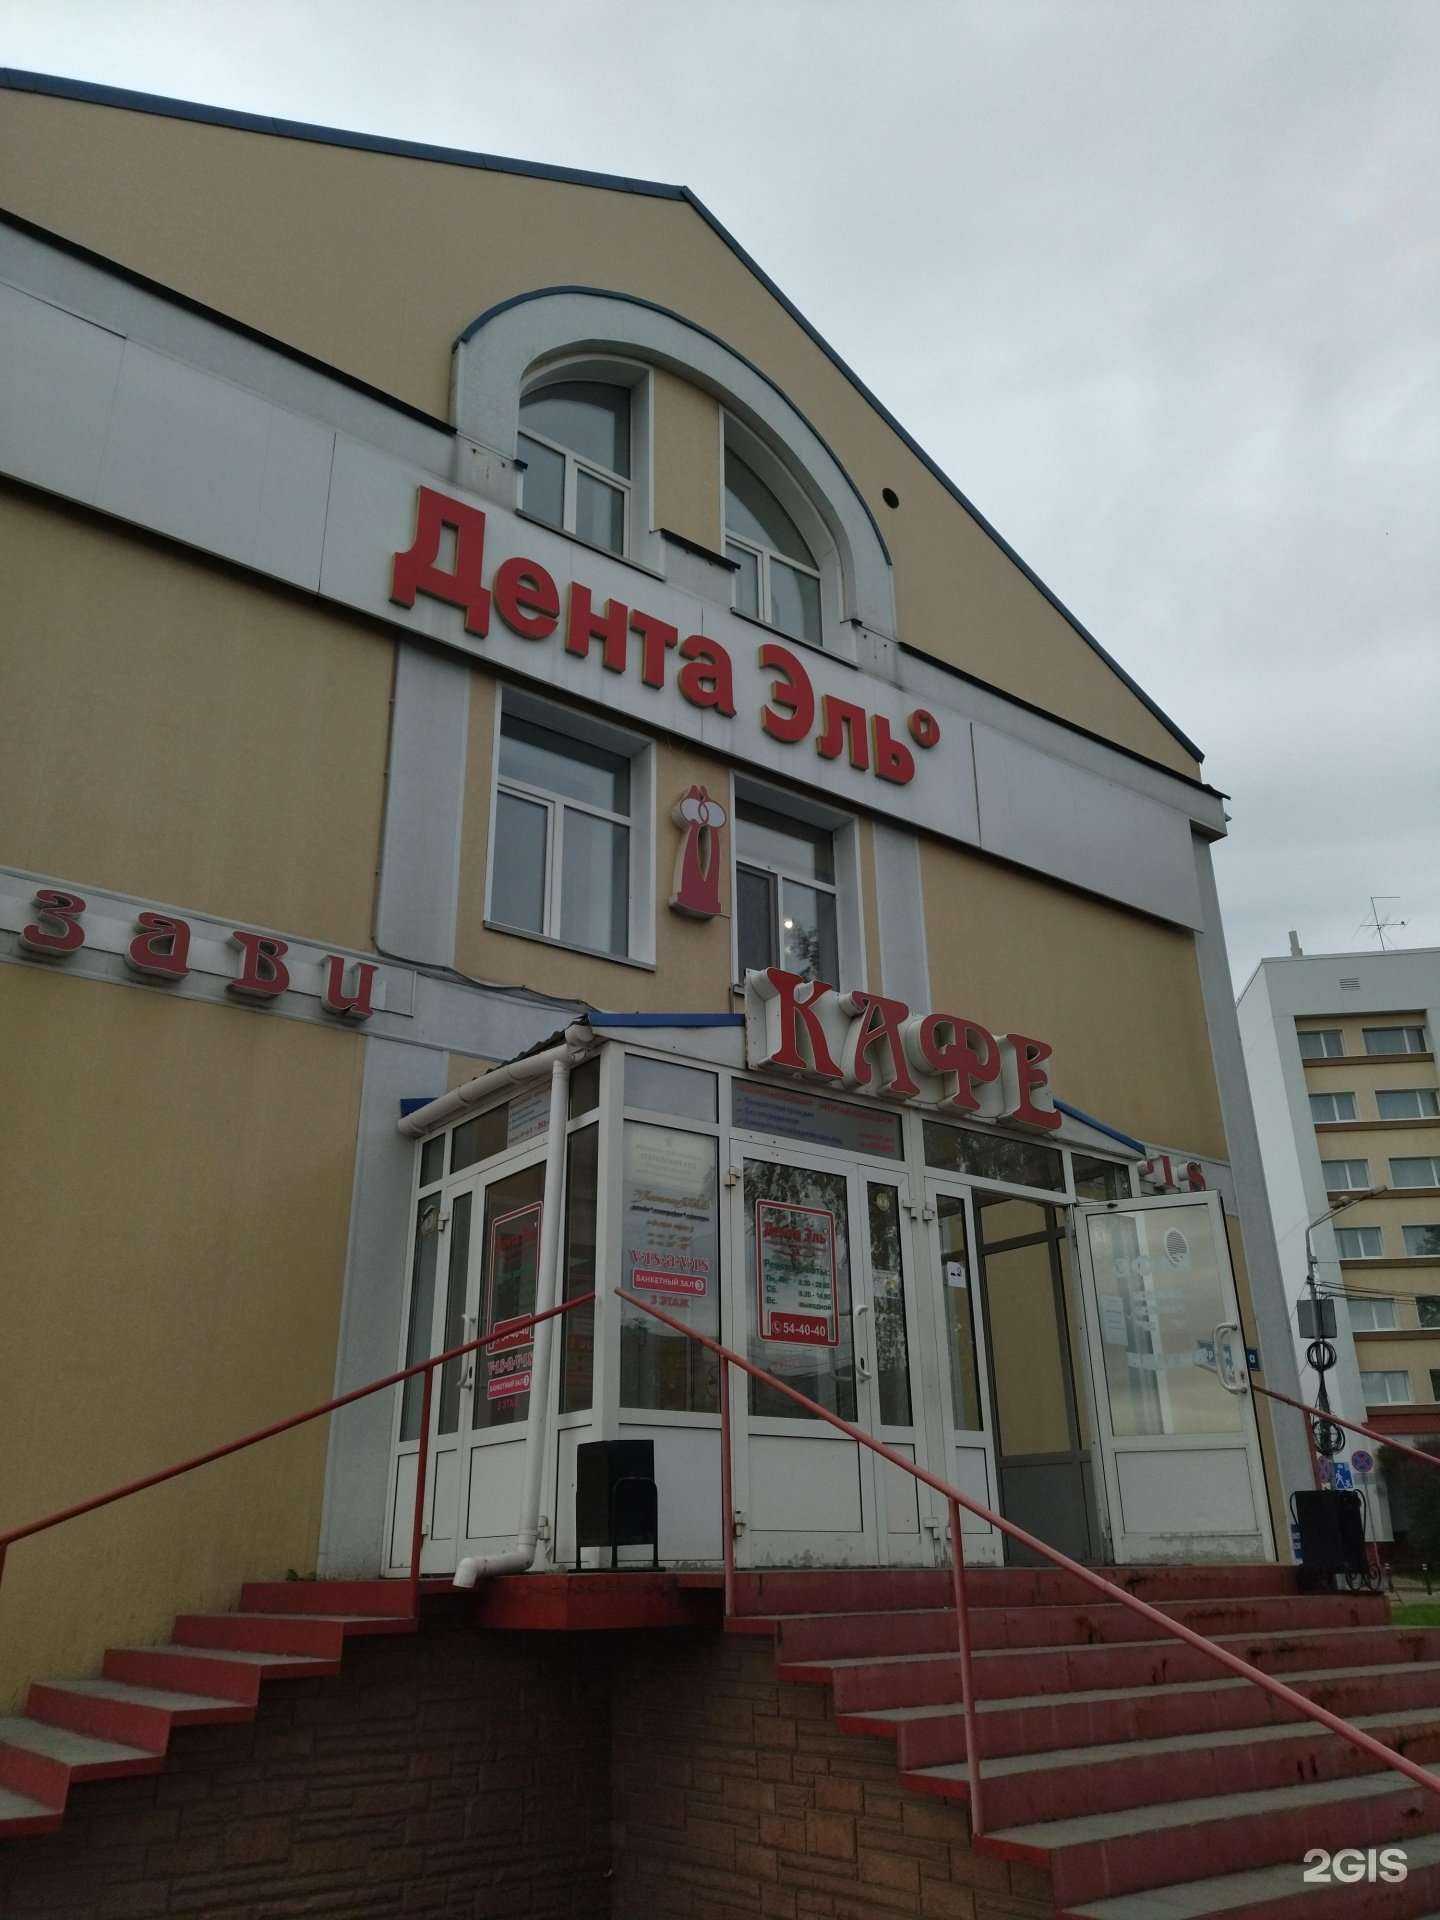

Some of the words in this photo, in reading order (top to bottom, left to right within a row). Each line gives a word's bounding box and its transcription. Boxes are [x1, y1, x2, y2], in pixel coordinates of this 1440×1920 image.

[388, 484, 738, 719] Дента
[765, 966, 1063, 1132] КАФЕ
[783, 1321, 826, 1337] 54-40-40
